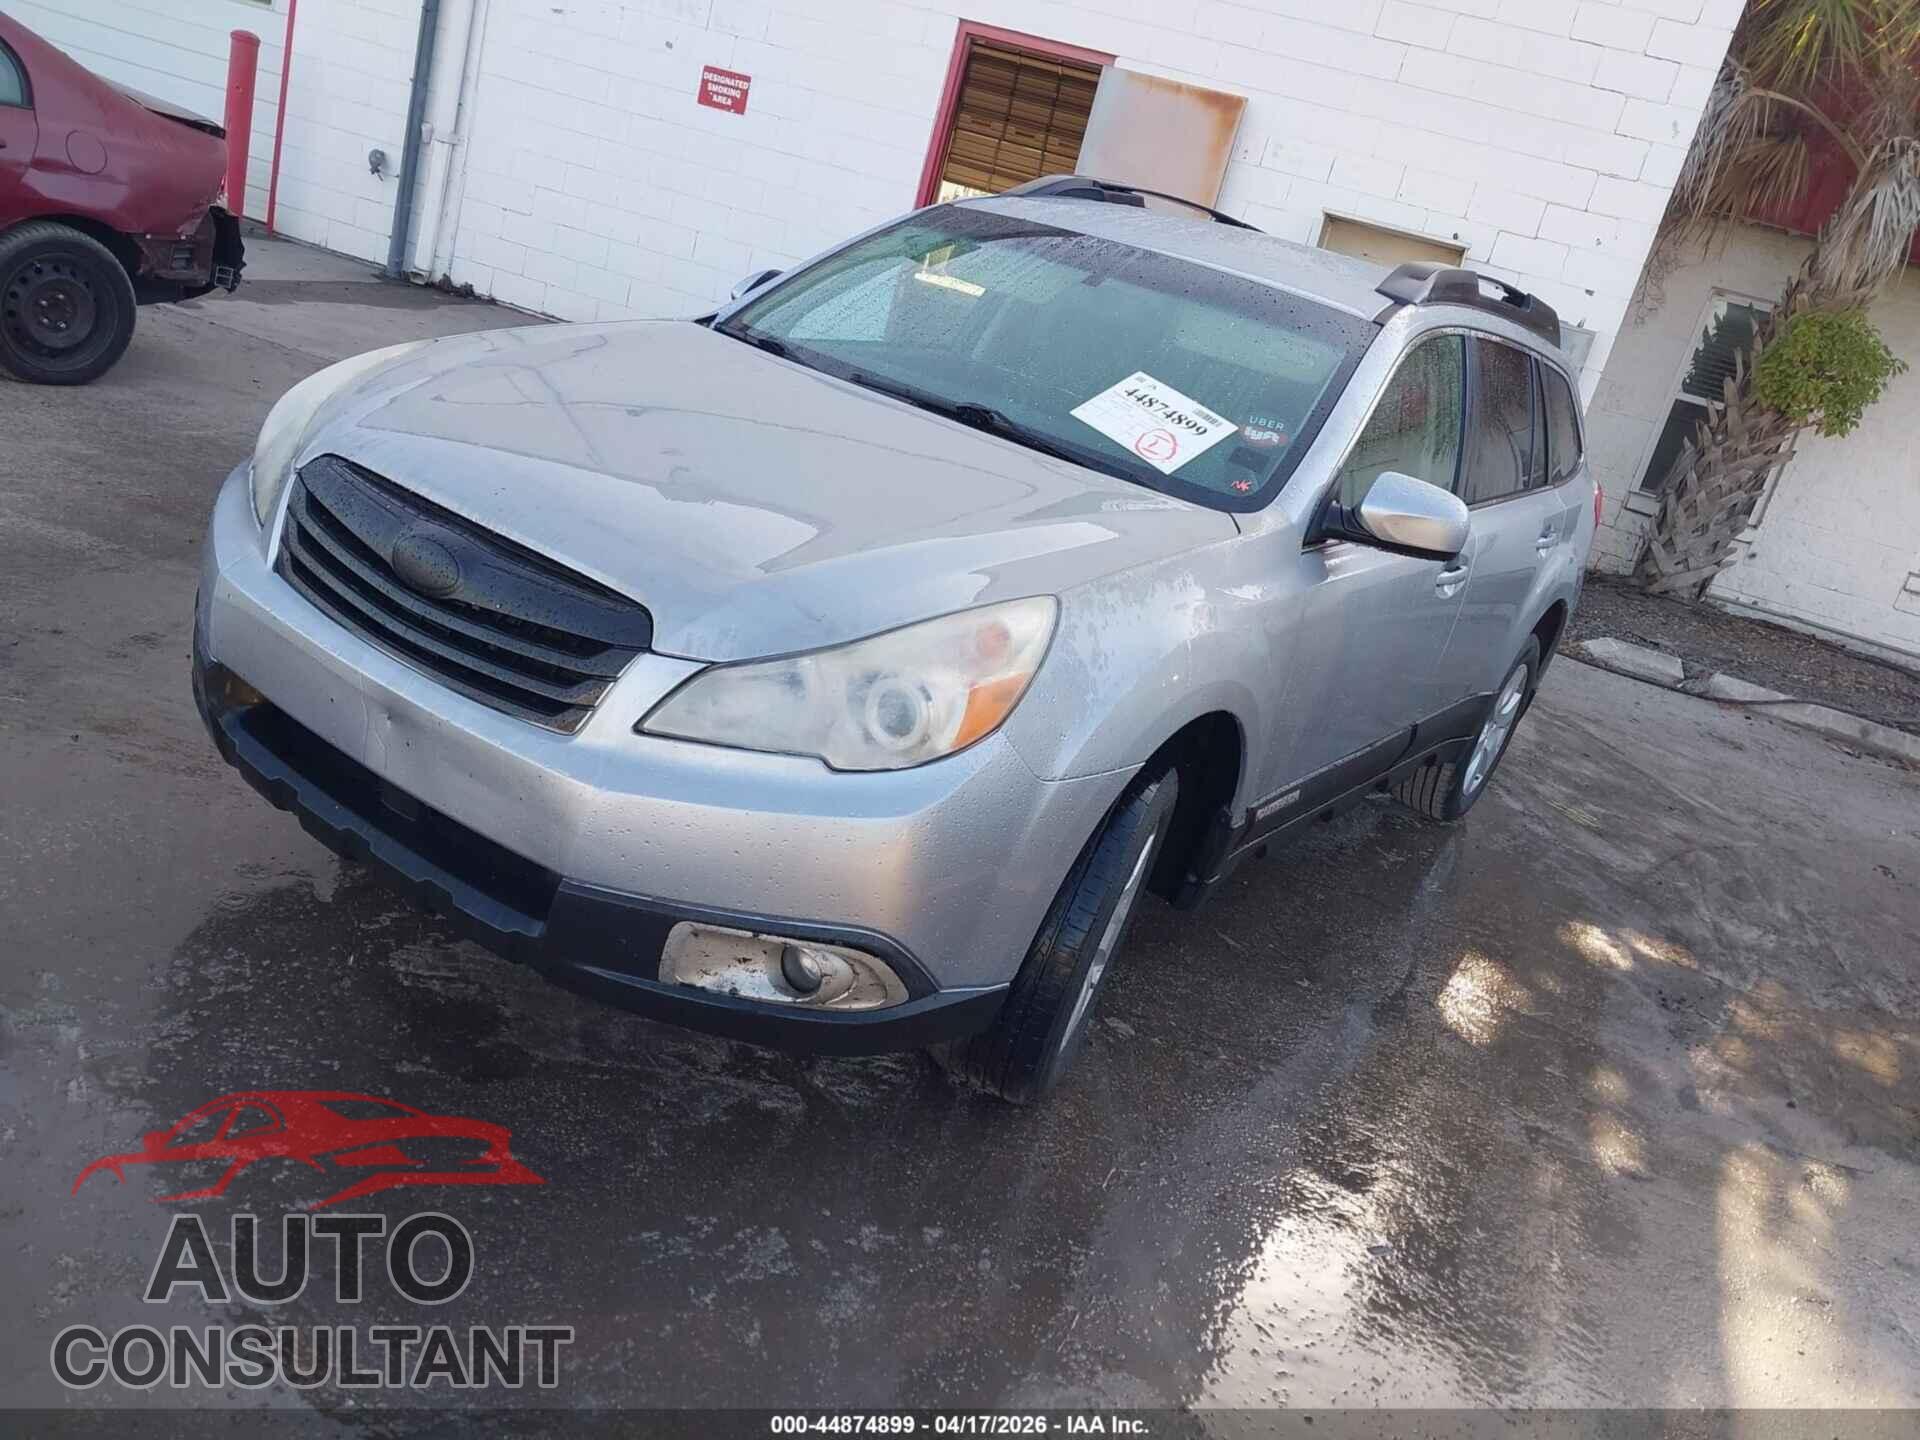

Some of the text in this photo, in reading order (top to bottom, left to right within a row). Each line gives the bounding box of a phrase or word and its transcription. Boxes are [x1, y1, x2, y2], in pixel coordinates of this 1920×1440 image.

[703, 71, 749, 90] DESIGNATED
[707, 82, 741, 99] SMOKING
[712, 94, 732, 106] AREA
[1125, 387, 1208, 436] 44874899
[1249, 415, 1285, 430] UBER
